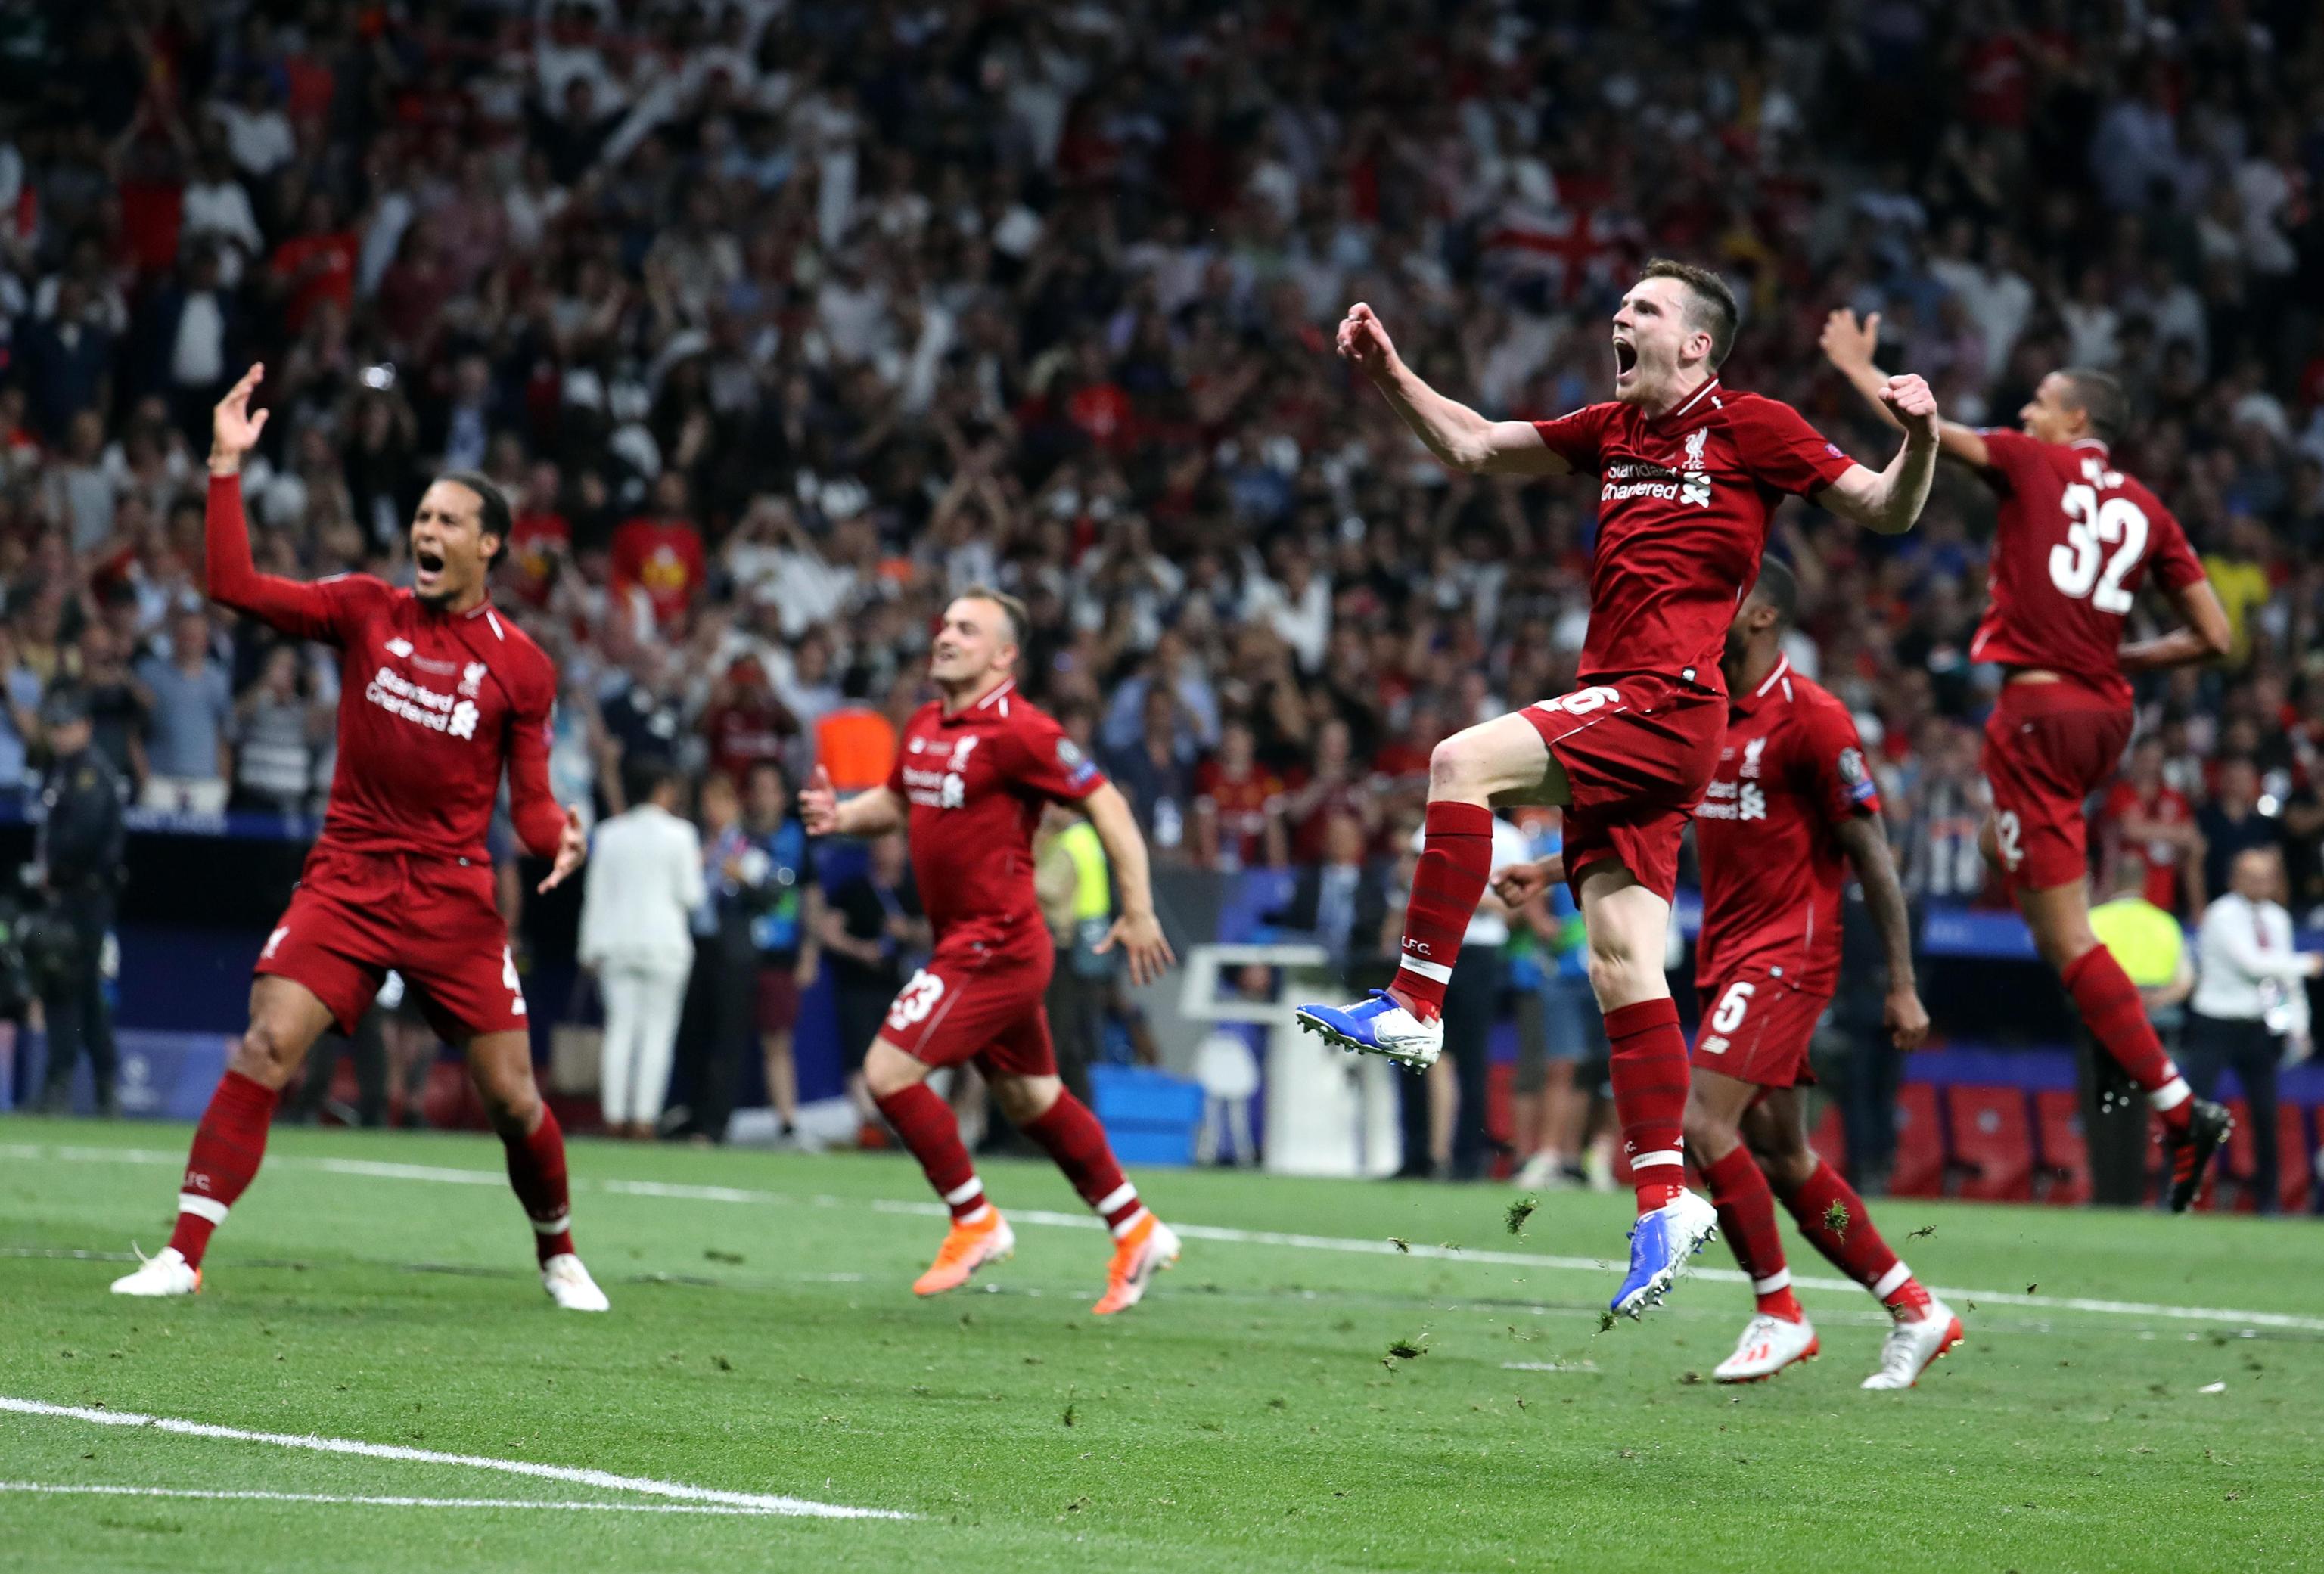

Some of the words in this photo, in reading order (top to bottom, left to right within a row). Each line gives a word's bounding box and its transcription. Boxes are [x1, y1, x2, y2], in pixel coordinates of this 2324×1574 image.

[1600, 481, 1679, 501] Chartered
[2049, 482, 2149, 616] 32
[365, 681, 449, 733] Chartered
[376, 666, 455, 713] Standard
[1712, 981, 1755, 1034] 5
